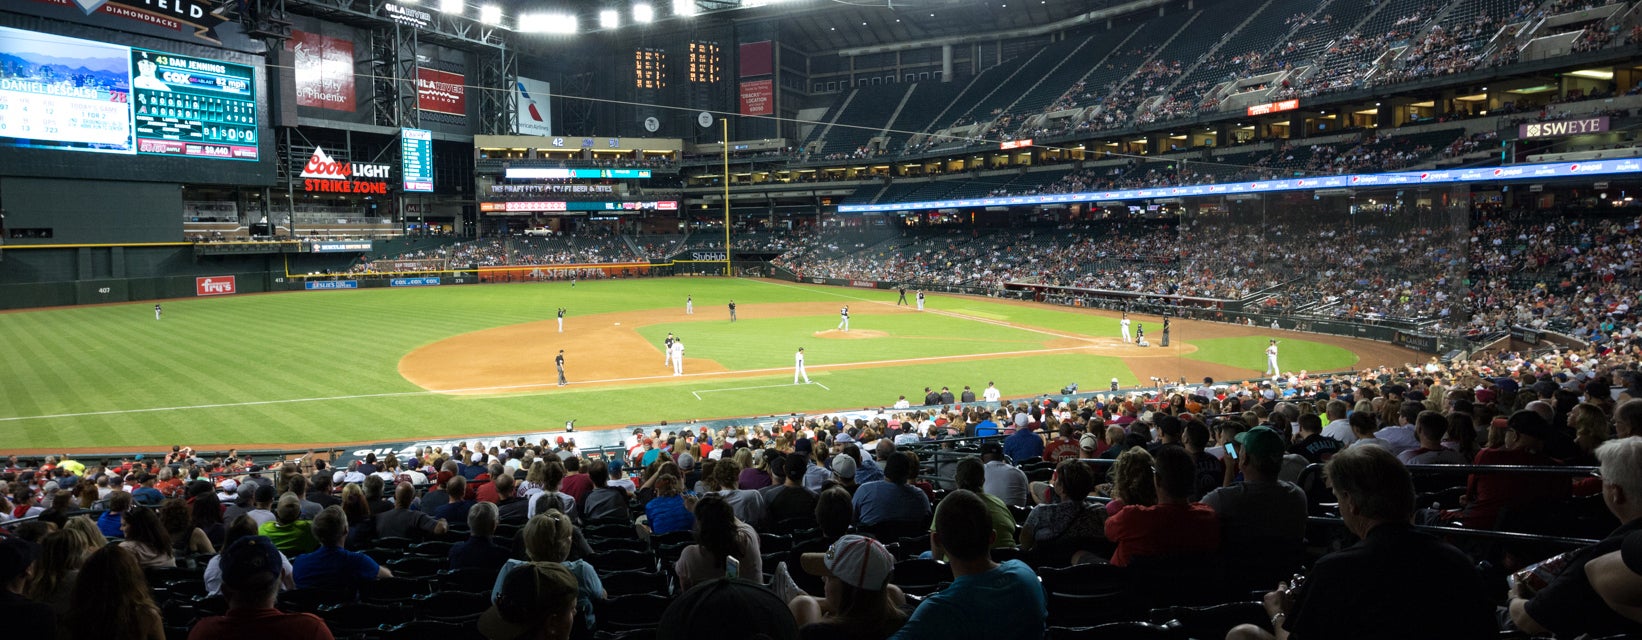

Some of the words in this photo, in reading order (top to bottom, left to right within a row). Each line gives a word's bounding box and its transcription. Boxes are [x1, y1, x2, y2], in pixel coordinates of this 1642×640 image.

[385, 3, 406, 14] GILA
[106, 6, 178, 28] DIAMONDBACKS
[156, 56, 168, 65] 43
[170, 58, 186, 68] DAN
[188, 60, 226, 74] JENNINGS
[2, 79, 46, 93] DANIEL
[47, 84, 98, 99] DESCALSO
[228, 80, 246, 90] mph
[308, 90, 346, 103] Phoenix
[420, 94, 456, 104] CASINOS
[1542, 118, 1600, 136] SWEYE
[552, 138, 563, 147] 42
[205, 146, 228, 155] $9,440
[304, 155, 352, 176] Coors
[352, 164, 390, 178] LIGHT
[1503, 168, 1522, 177] pepsi
[1581, 163, 1602, 173] pepsi
[304, 179, 351, 192] STRIKE
[353, 181, 386, 194] ZONE
[692, 252, 727, 262] StubHub
[201, 279, 232, 292] fry's
